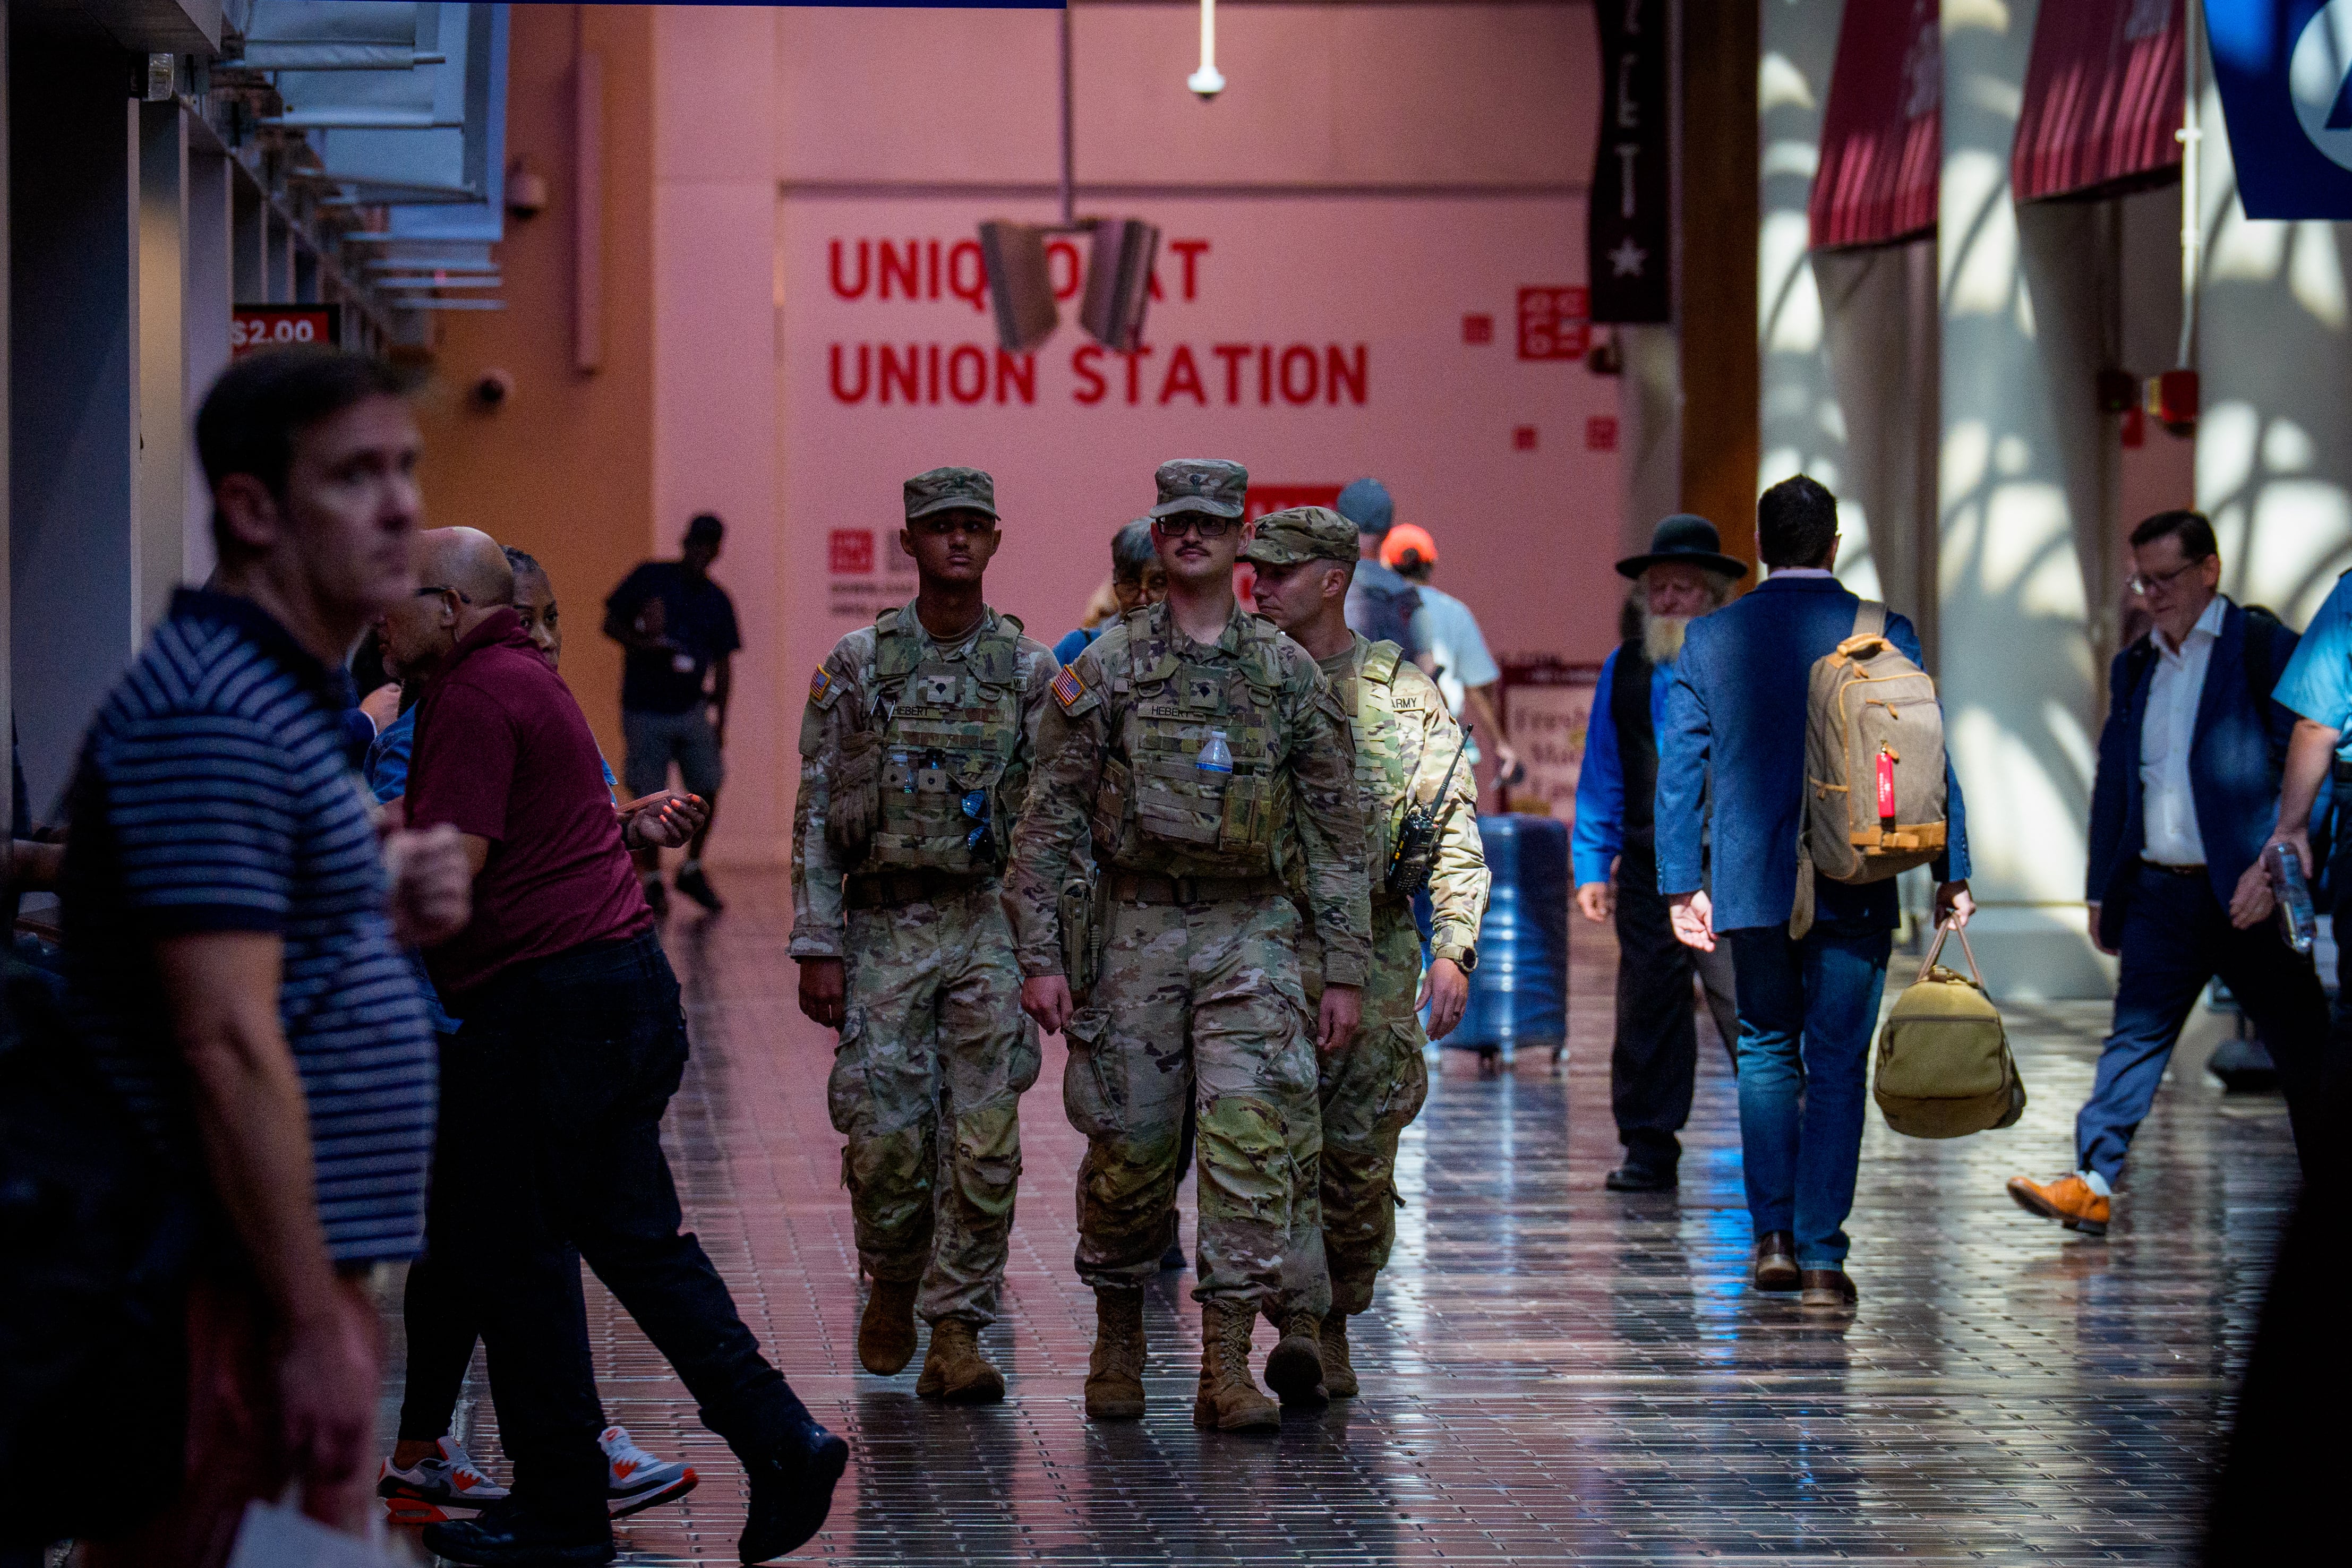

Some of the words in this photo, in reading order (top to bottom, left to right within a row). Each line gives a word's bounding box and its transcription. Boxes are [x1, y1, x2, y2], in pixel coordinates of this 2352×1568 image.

[828, 239, 1081, 313] UNIQO
[828, 344, 1036, 406] UNION
[1072, 344, 1367, 406] STATION
